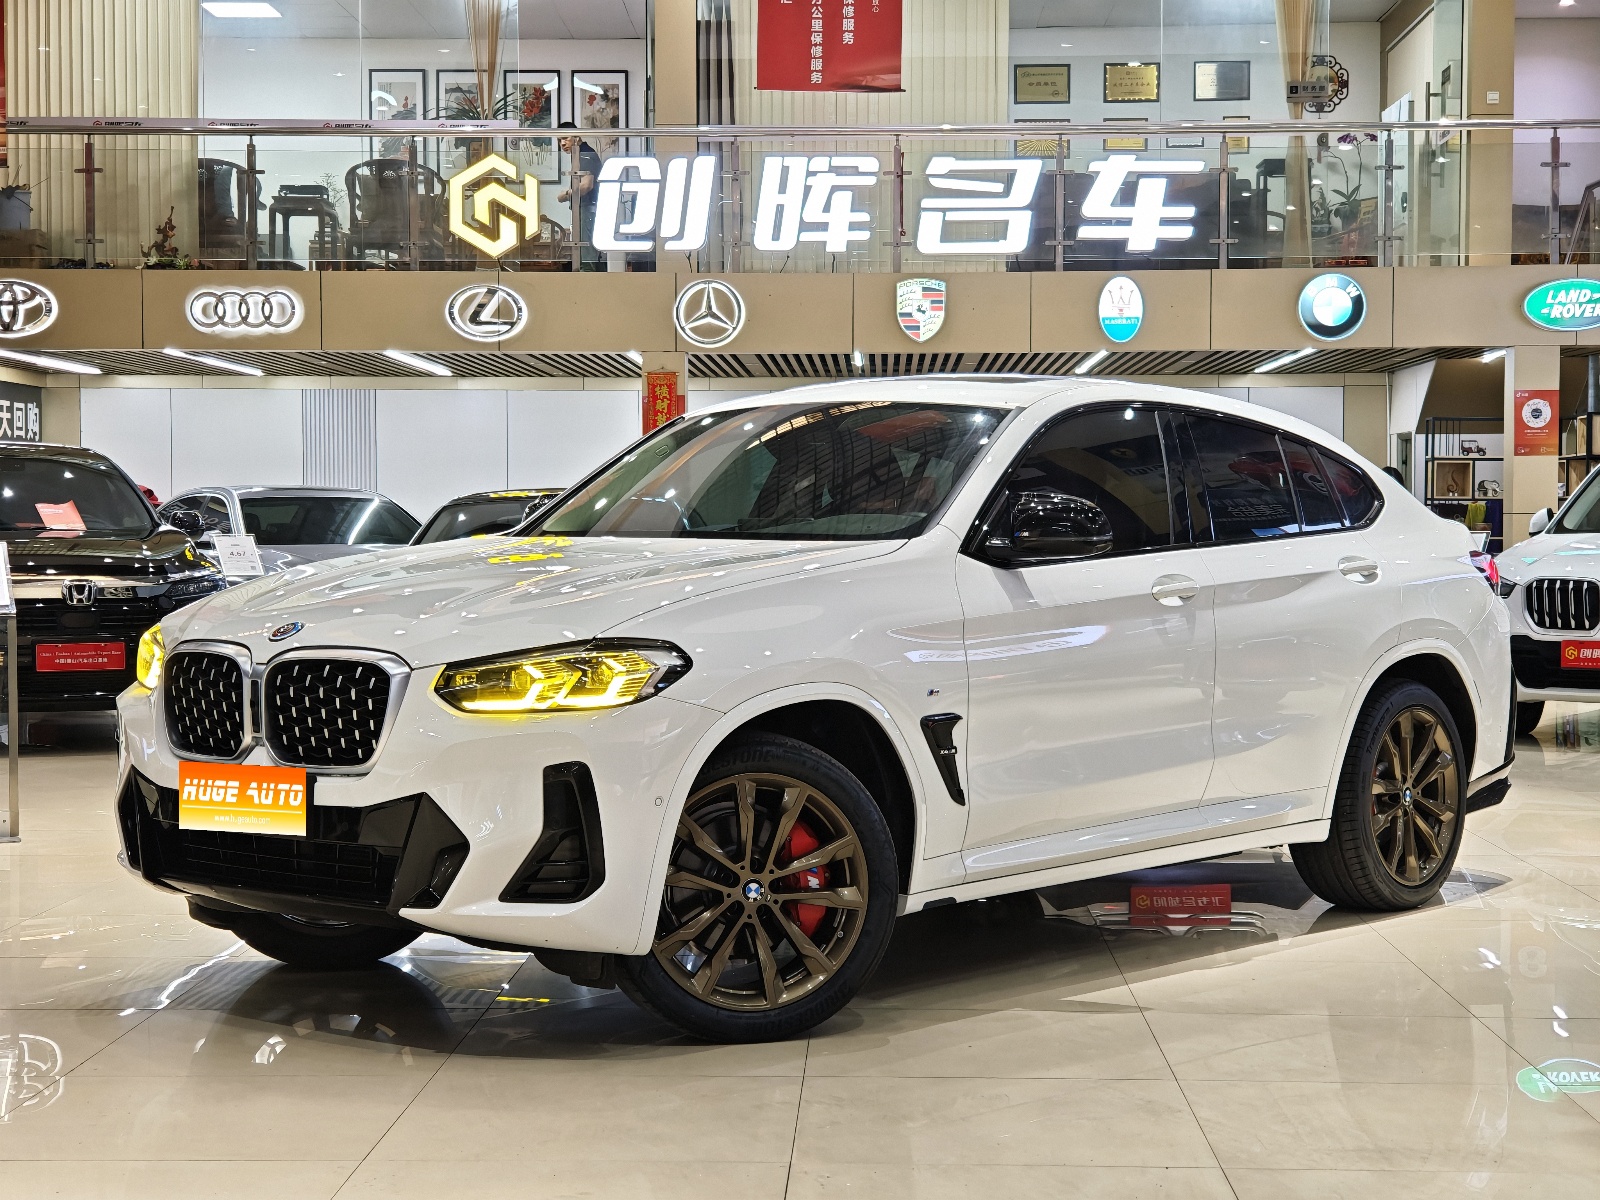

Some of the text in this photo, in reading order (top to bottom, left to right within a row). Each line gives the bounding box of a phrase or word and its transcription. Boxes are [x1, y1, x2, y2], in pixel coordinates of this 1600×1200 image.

[1305, 276, 1361, 299] BMW
[1545, 289, 1592, 304] LAND
[0, 400, 40, 442] 天回购
